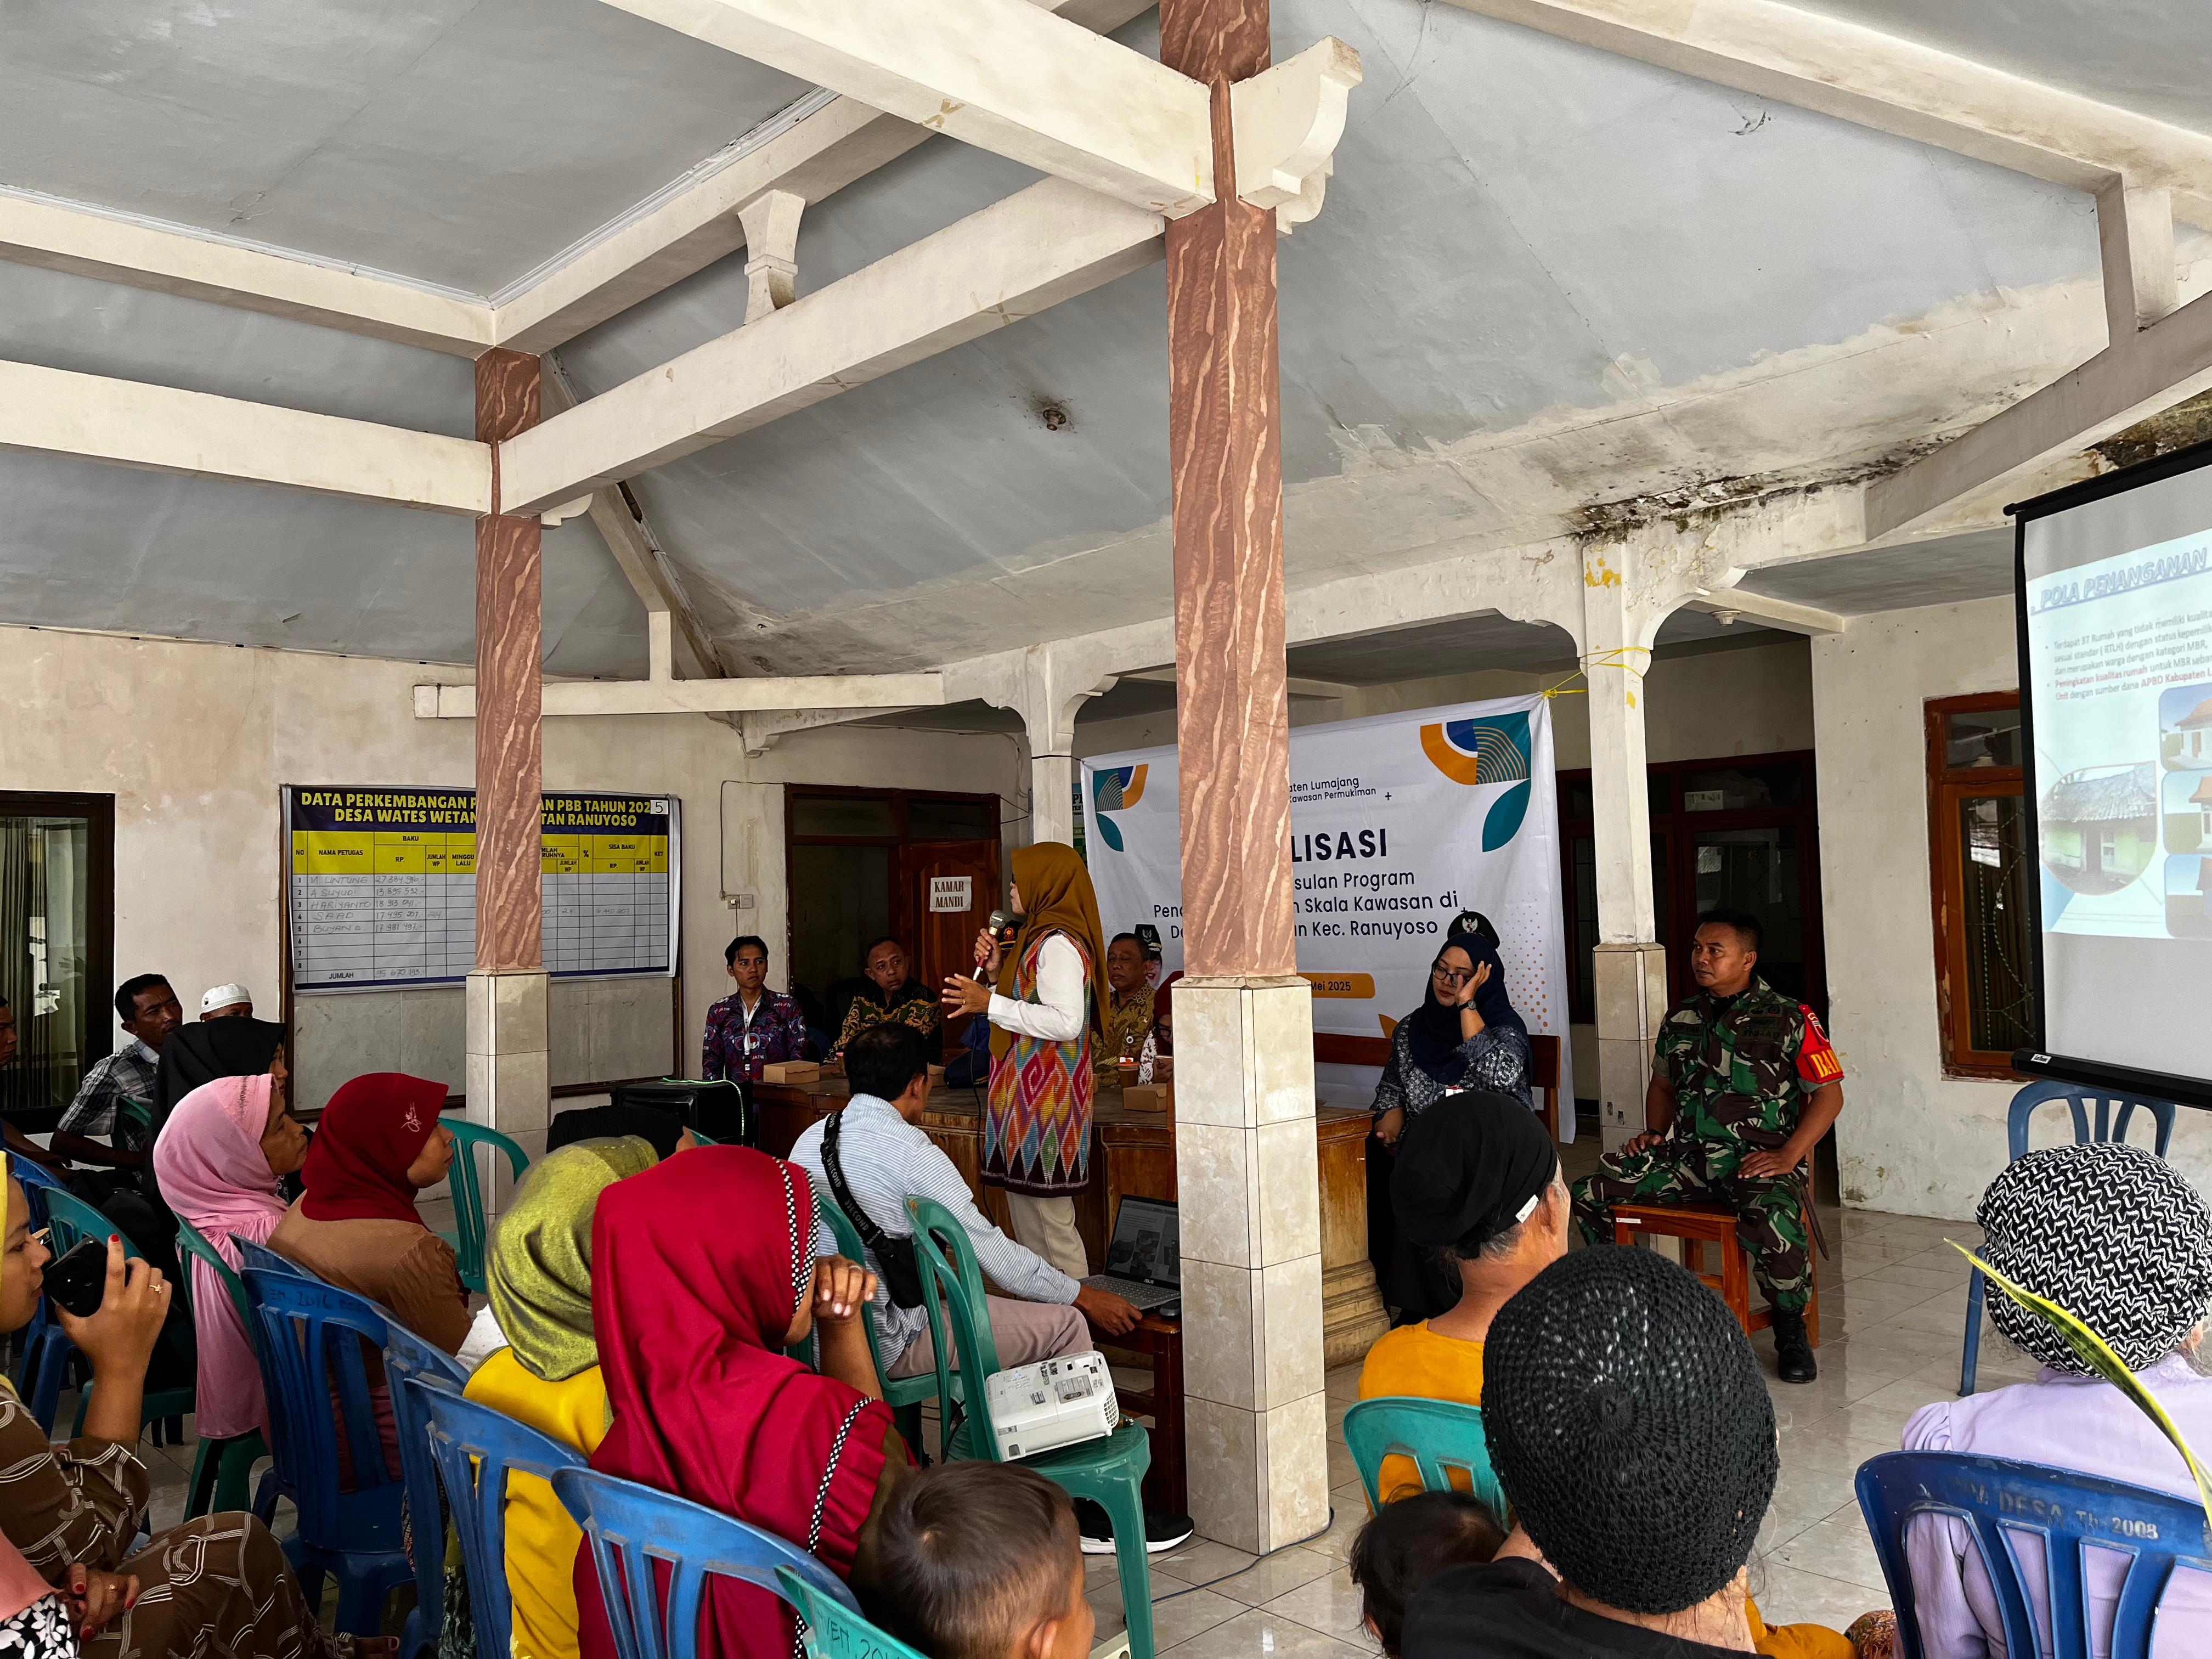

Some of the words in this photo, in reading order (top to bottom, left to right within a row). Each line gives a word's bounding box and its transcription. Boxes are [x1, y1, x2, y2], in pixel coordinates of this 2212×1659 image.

[2041, 582, 2079, 607] POLA
[2084, 548, 2207, 598] PENANGANAN
[2091, 630, 2115, 643] Rumah
[2117, 627, 2132, 639] yang
[2134, 621, 2153, 634] tidak
[2125, 637, 2153, 650] dengan
[2155, 632, 2177, 643] status
[2123, 664, 2148, 677] rumah
[2173, 657, 2191, 668] MBR
[2165, 670, 2205, 684] Kabupaten
[1311, 777, 1359, 791] Lumajang
[302, 792, 342, 806] DATA
[346, 793, 467, 809] PERKEMBANGAN
[1324, 787, 1376, 800] Permukiman
[557, 800, 582, 812] PBB
[584, 800, 625, 812] TAHUN
[335, 809, 374, 822] DESA
[376, 809, 426, 823] WATES
[568, 814, 637, 827] RANUYOSO
[1291, 828, 1387, 862] LISASI
[934, 881, 964, 893] KAMAR
[1294, 873, 1338, 890] sulan
[1344, 872, 1414, 892] Program
[935, 896, 963, 907] MANDI
[1305, 896, 1348, 913] Skala
[1355, 895, 1433, 912] Kawasan
[1440, 890, 1458, 908] di
[1312, 922, 1345, 936] Kec.
[1351, 921, 1438, 940] Ranuyoso
[1328, 981, 1351, 992] 2025
[2111, 1516, 2159, 1541] 2008
